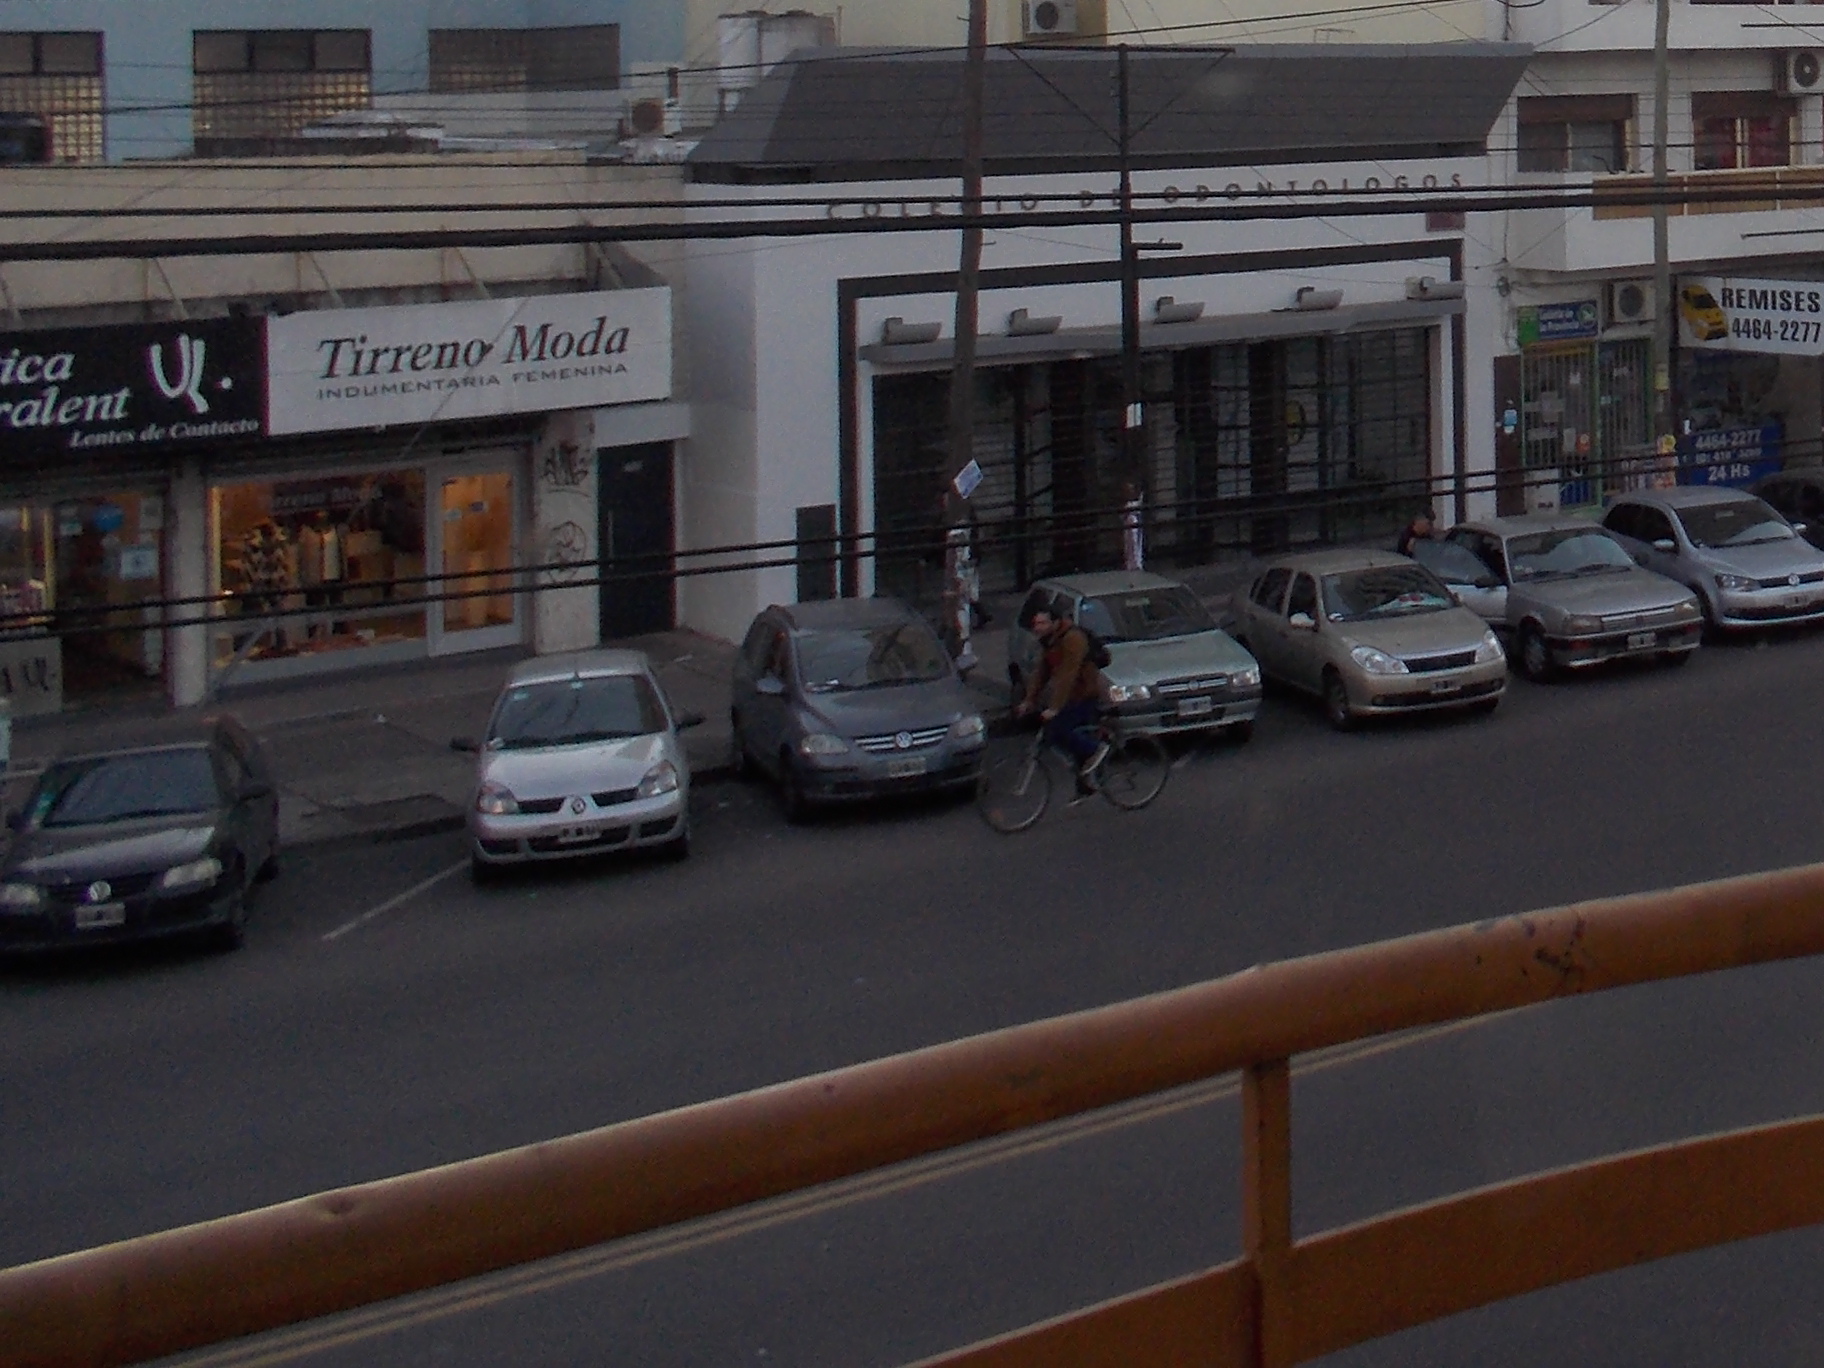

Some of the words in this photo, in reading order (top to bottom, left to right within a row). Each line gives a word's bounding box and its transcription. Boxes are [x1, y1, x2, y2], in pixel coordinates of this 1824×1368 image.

[826, 192, 1038, 219] COLEIO
[1162, 172, 1463, 204] ODONTOLOGOS
[1721, 287, 1821, 313] REMISES
[1732, 317, 1821, 343] 4464-2277
[319, 334, 490, 380] Tirreno
[503, 316, 630, 365] Moda
[317, 374, 501, 401] INDUMENTARIA
[511, 362, 629, 384] FEMENINA
[69, 429, 135, 449] Lentes
[140, 422, 166, 442] de
[168, 419, 260, 439] Contacto
[1695, 429, 1762, 451] 4464-2277
[1708, 464, 1726, 482] 24
